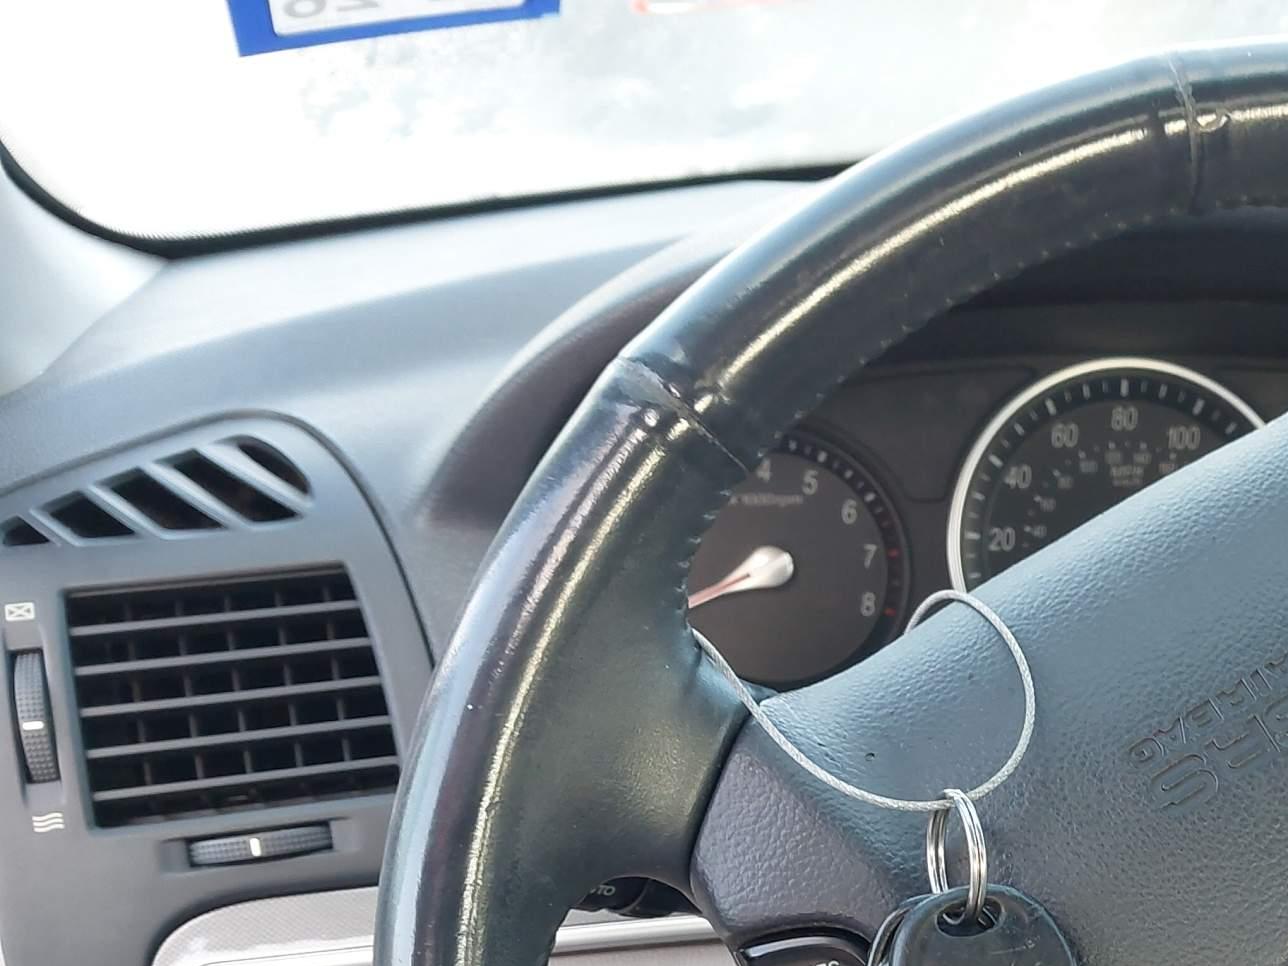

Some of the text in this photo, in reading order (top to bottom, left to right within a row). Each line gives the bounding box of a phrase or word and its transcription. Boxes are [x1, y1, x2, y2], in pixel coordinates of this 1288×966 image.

[1111, 404, 1138, 431] 80
[1051, 423, 1079, 448] 60
[1166, 426, 1200, 449] 100
[755, 459, 771, 481] 4
[802, 469, 818, 496] 5
[1004, 464, 1032, 489] 40
[841, 498, 857, 525] 6
[989, 528, 1016, 551] 20
[863, 543, 877, 569] 7
[860, 590, 876, 617] 8
